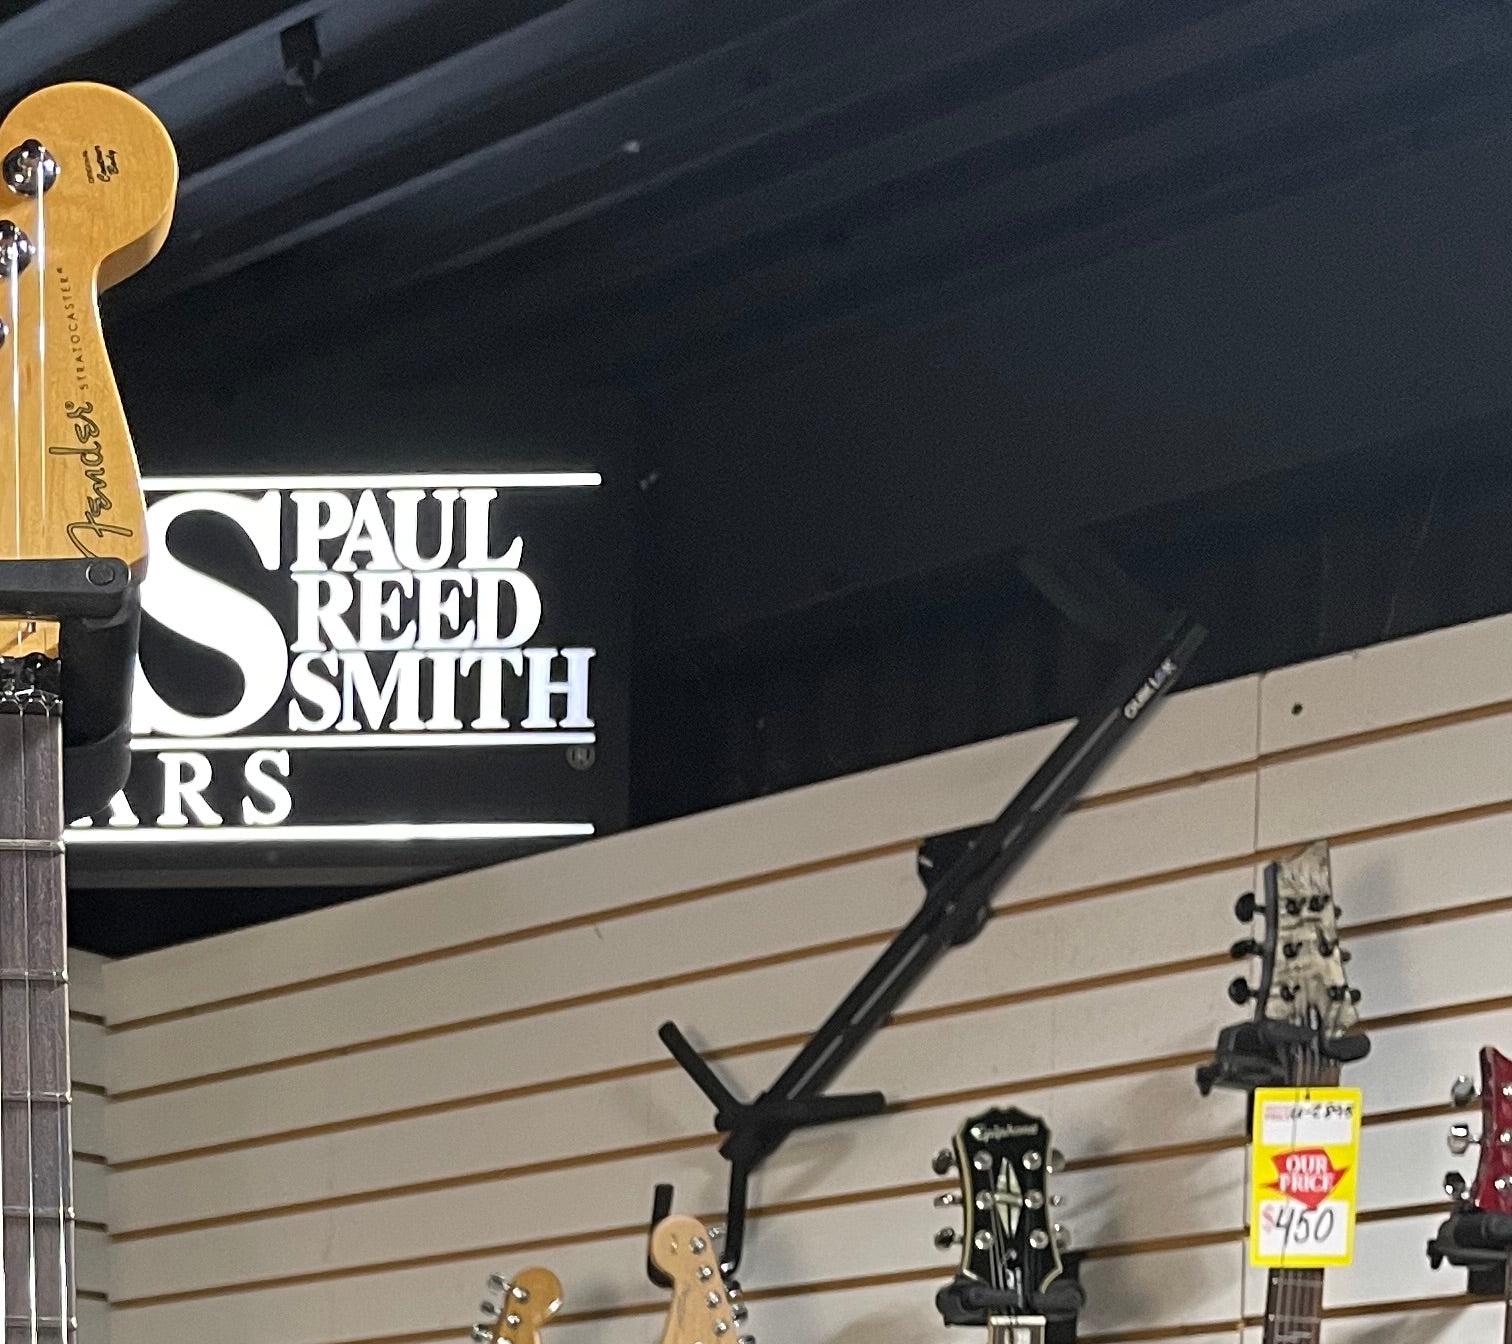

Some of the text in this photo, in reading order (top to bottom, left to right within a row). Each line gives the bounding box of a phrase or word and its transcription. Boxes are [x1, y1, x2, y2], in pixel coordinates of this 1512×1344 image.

[59, 275, 90, 391] STRATOCASTER
[48, 401, 134, 559] Fender
[289, 488, 524, 572] PAUL
[290, 568, 542, 652] REED
[288, 647, 597, 732] SMITH
[1279, 1171, 1337, 1195] PRICE
[1285, 1153, 1329, 1175] OUR
